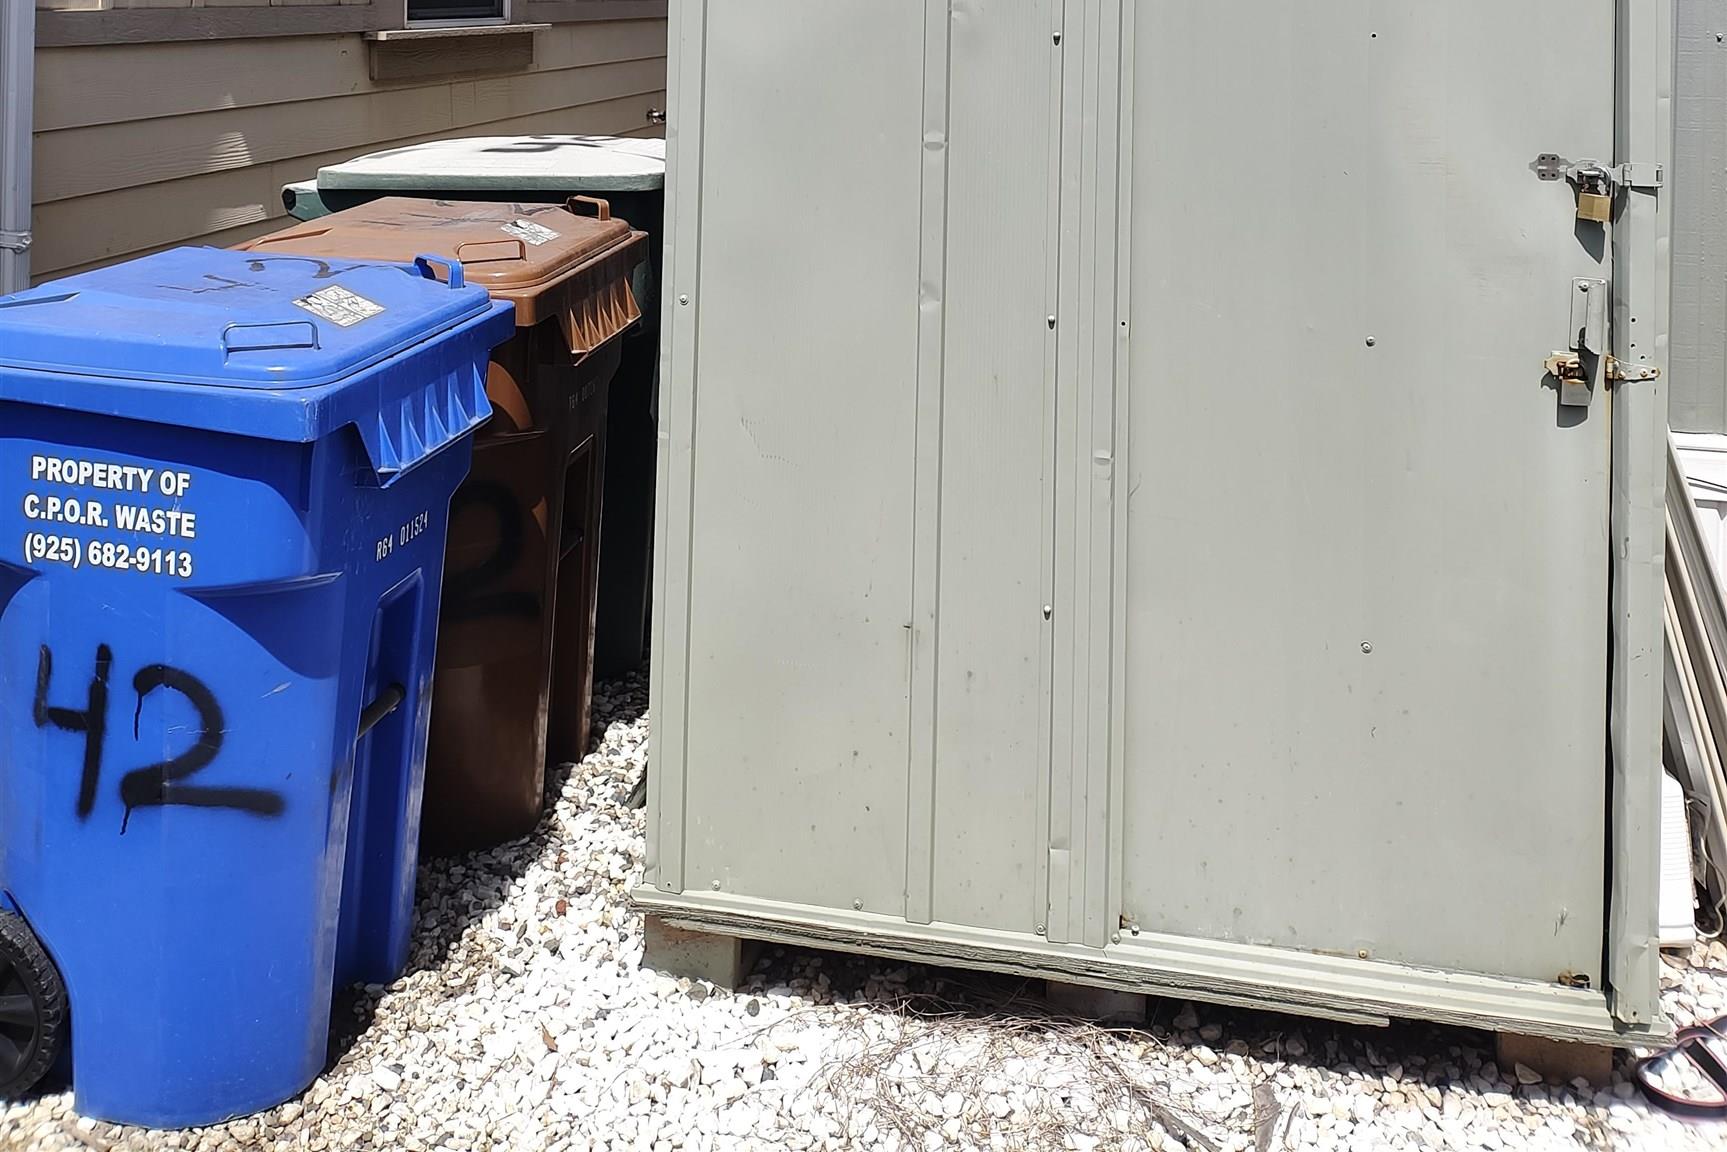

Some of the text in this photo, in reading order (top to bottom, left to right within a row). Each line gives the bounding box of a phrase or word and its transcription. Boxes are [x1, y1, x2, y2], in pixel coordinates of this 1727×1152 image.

[32, 455, 191, 497] PROPERTY OF
[24, 494, 196, 538] C.P.O.R. WASTE
[376, 510, 428, 562] R64 011524
[25, 532, 192, 578] (925) 682-9113
[34, 643, 286, 822] 42
